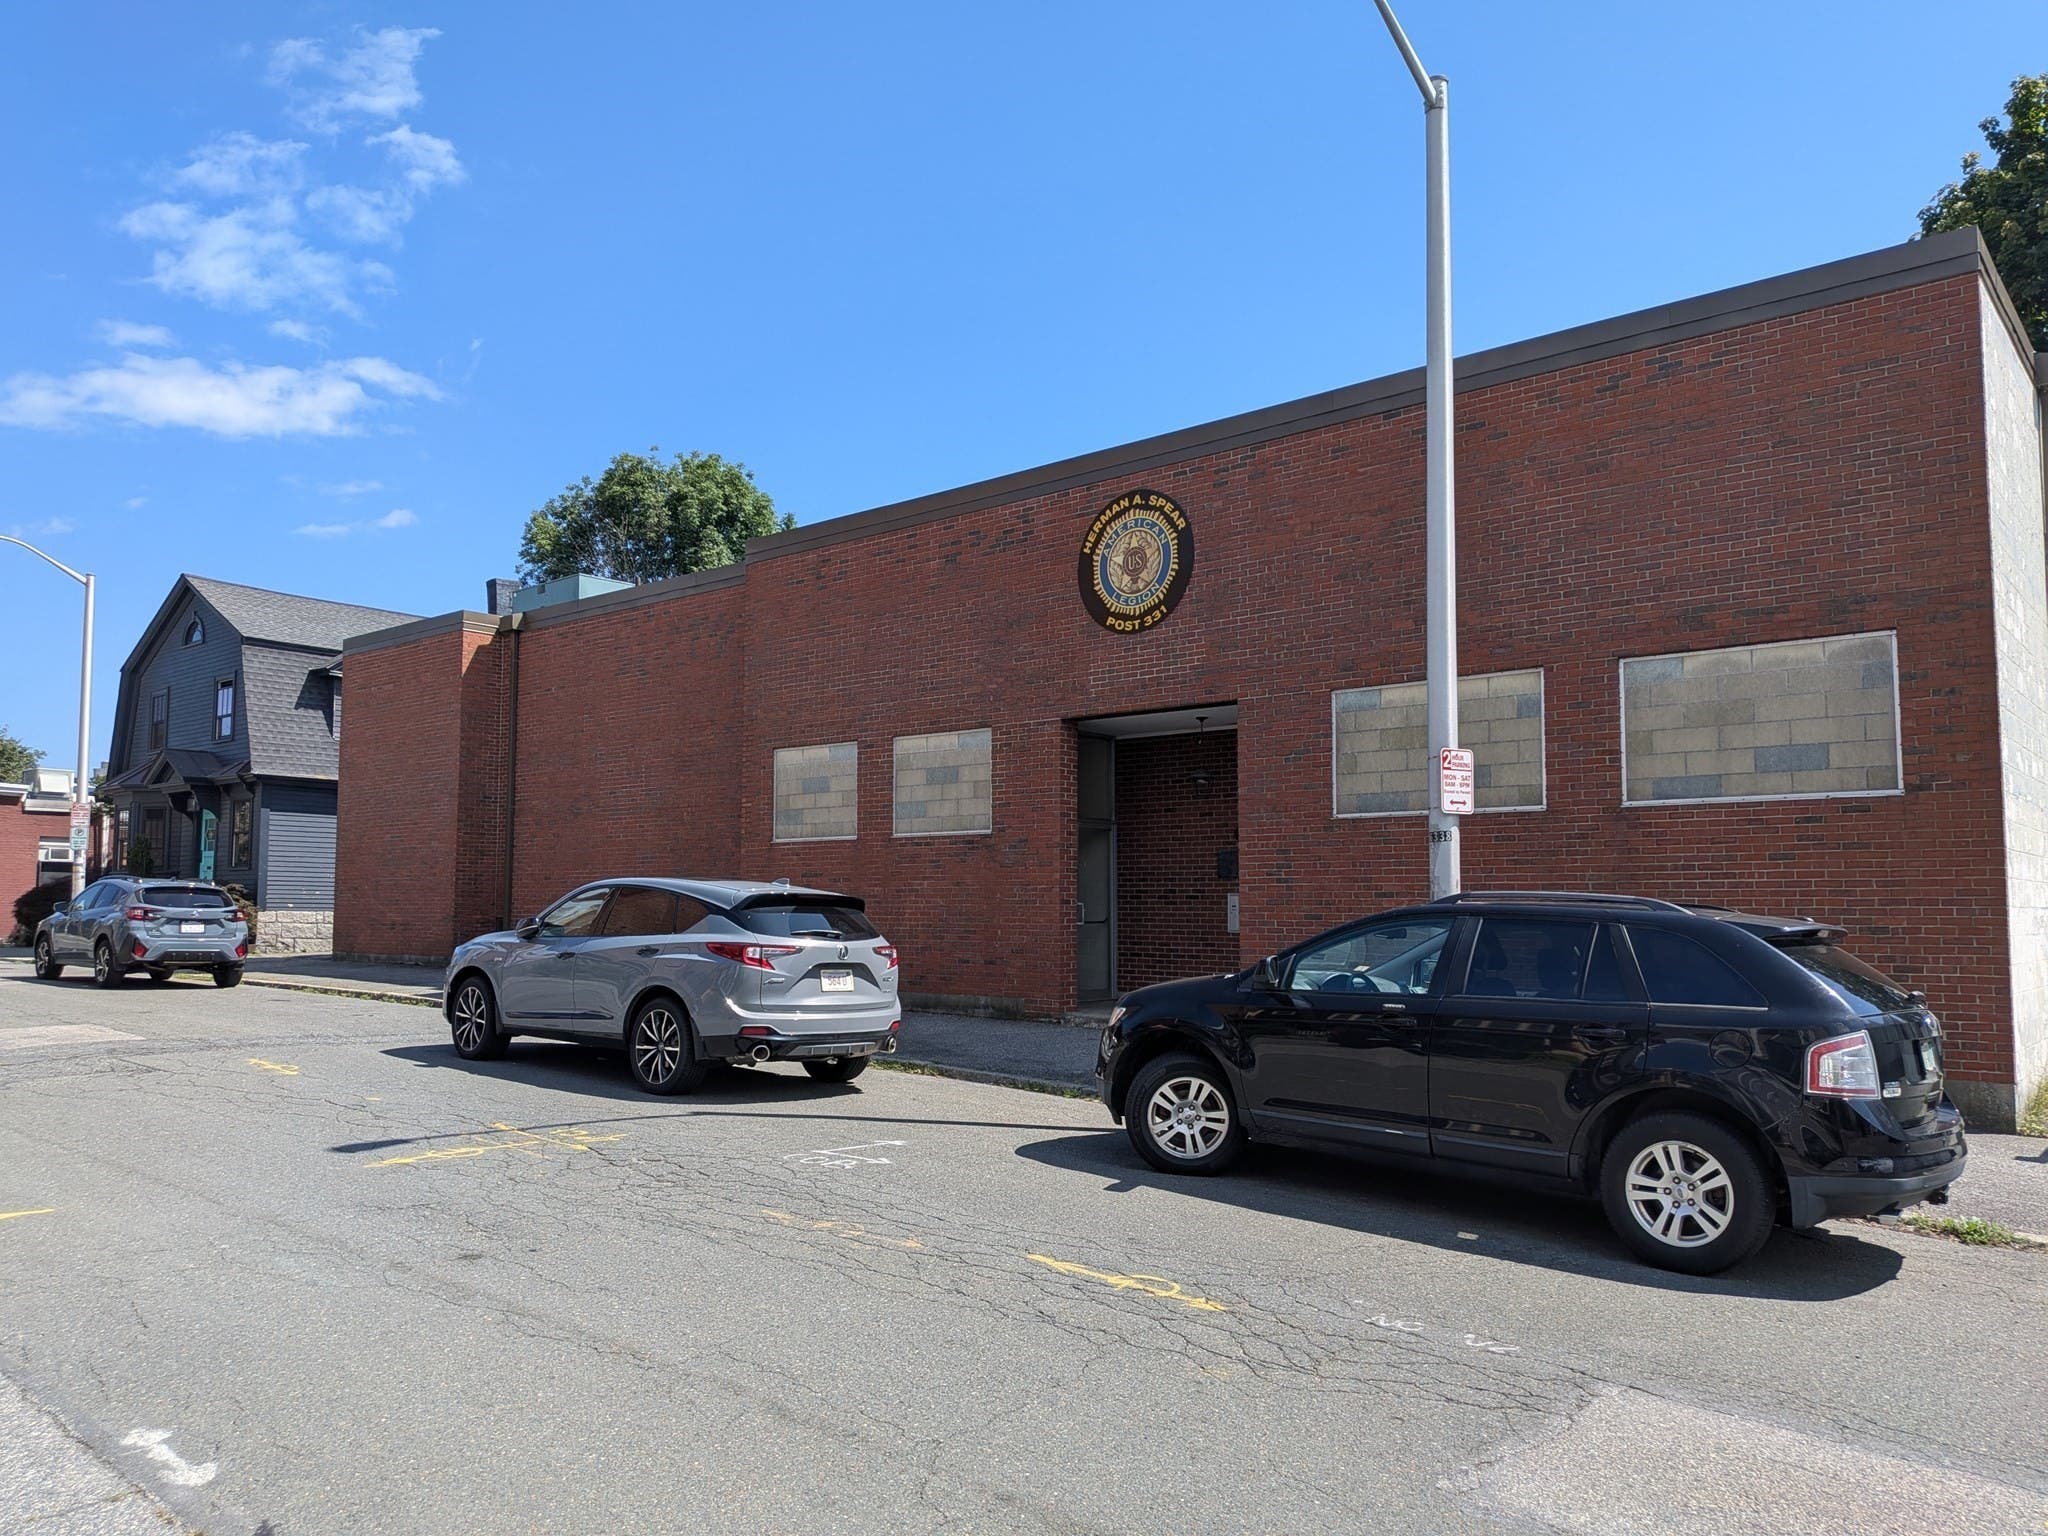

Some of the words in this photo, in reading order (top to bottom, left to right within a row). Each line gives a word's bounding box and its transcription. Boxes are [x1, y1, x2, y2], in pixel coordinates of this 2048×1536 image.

[1083, 498, 1129, 554] HERMAN
[1132, 494, 1145, 505] A.
[1148, 495, 1186, 530] SPEAR
[1103, 520, 1168, 557] AMERICAN
[1112, 583, 1160, 605] LEGION
[1106, 616, 1140, 631] POST
[1143, 605, 1167, 626] 331
[1443, 750, 1451, 768] 2
